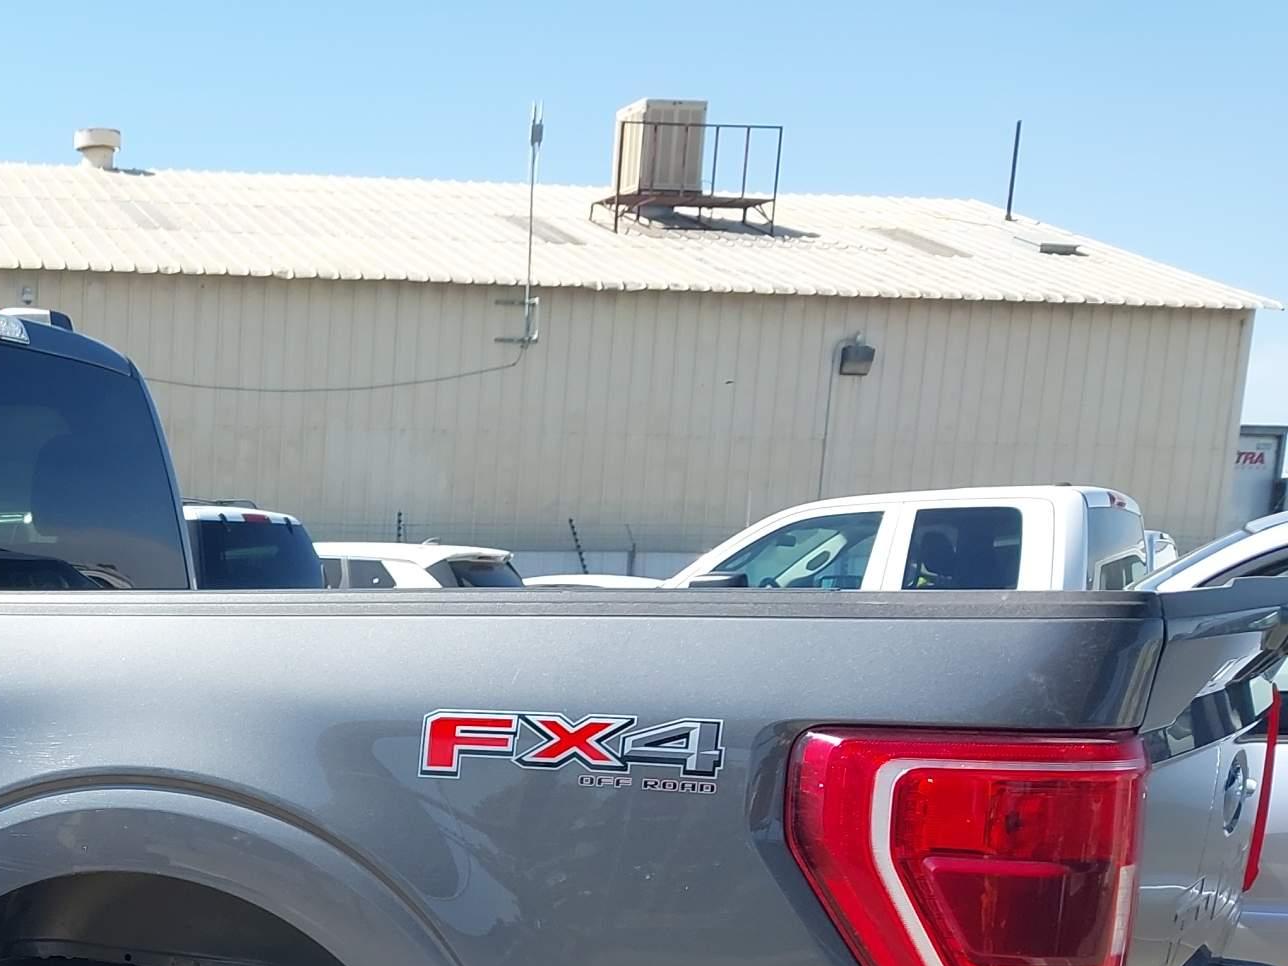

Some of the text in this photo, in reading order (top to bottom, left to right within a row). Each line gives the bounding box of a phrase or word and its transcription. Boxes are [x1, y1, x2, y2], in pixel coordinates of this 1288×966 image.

[418, 709, 726, 779] FX4
[578, 774, 717, 794] OFF ROAD
